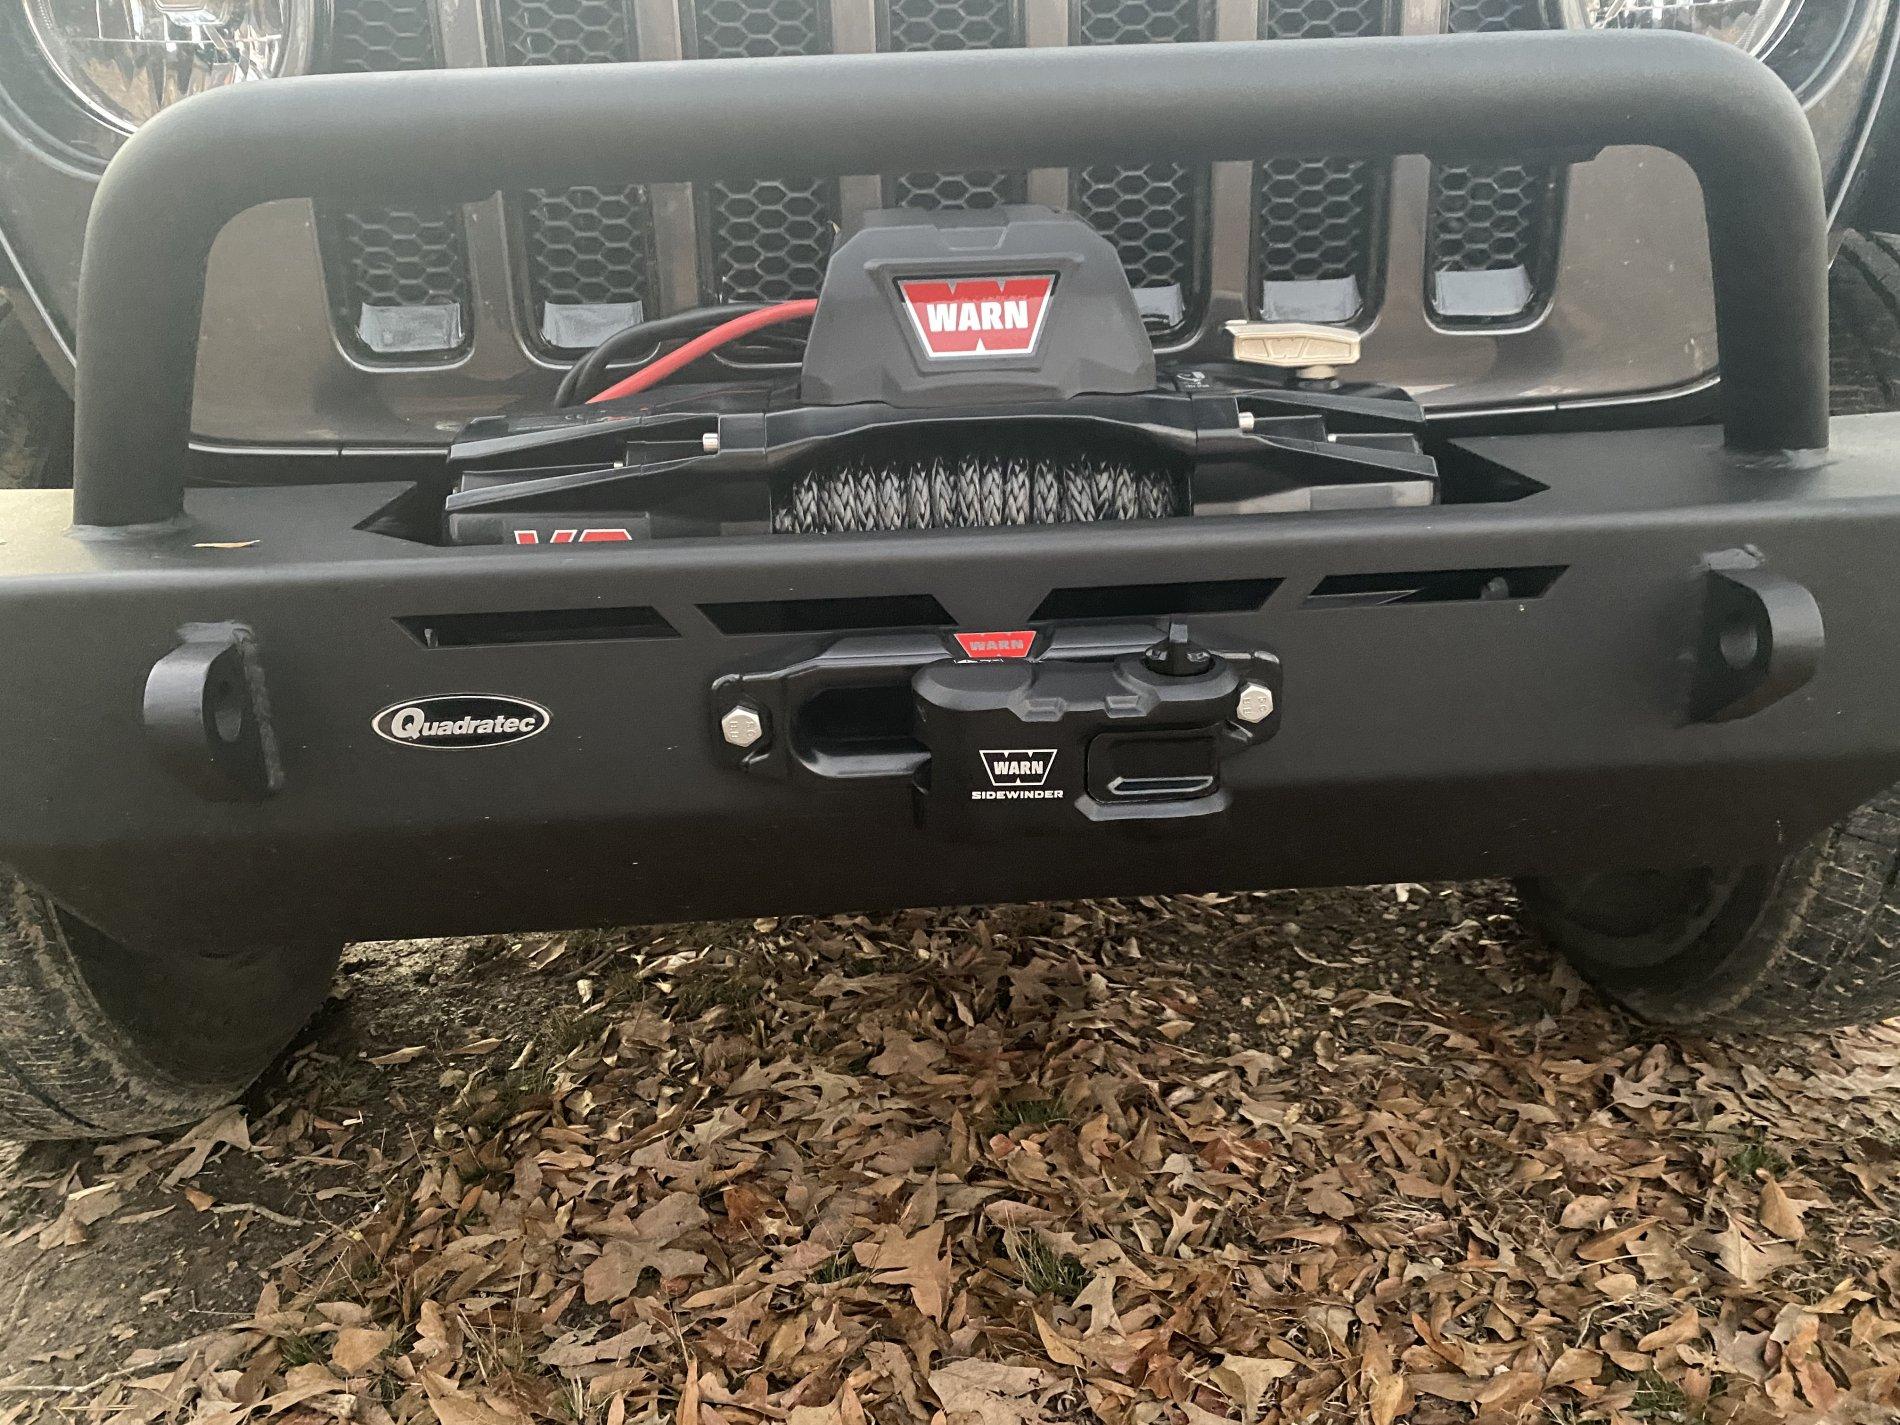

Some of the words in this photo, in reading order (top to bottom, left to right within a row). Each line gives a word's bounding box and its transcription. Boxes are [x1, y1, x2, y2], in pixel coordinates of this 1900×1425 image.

[926, 300, 1029, 333] WARN
[969, 640, 1024, 652] WARN
[391, 707, 536, 740] Quadratec
[993, 760, 1044, 775] WARN
[971, 789, 1064, 800] SIDEWINDER
